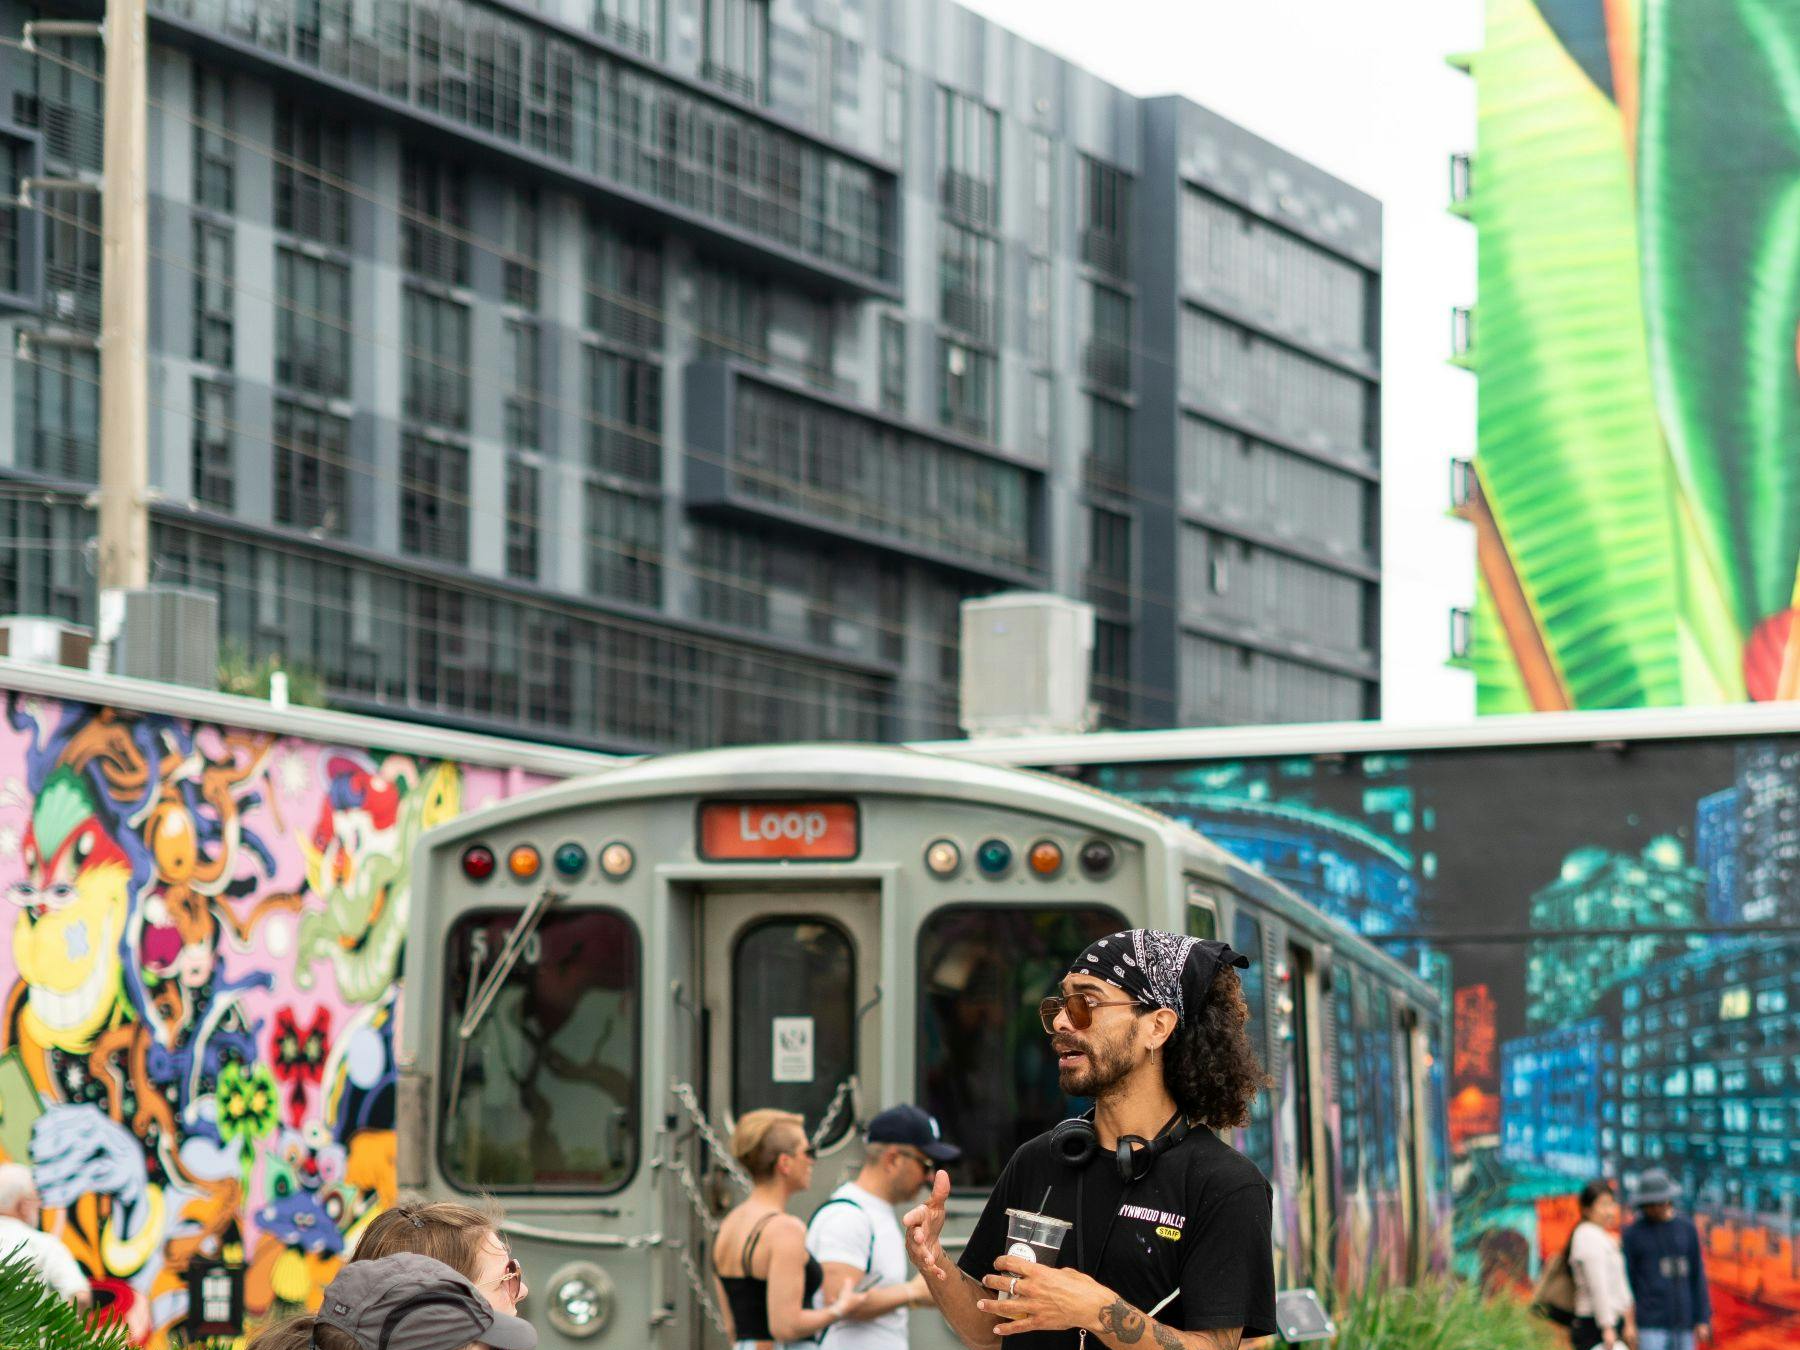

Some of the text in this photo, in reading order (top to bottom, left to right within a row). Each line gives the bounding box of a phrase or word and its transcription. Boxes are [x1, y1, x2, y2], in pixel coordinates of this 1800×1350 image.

[740, 806, 827, 844] Loop
[471, 928, 541, 964] 50
[1159, 1211, 1186, 1229] WALLS
[1159, 1228, 1180, 1238] STAFF
